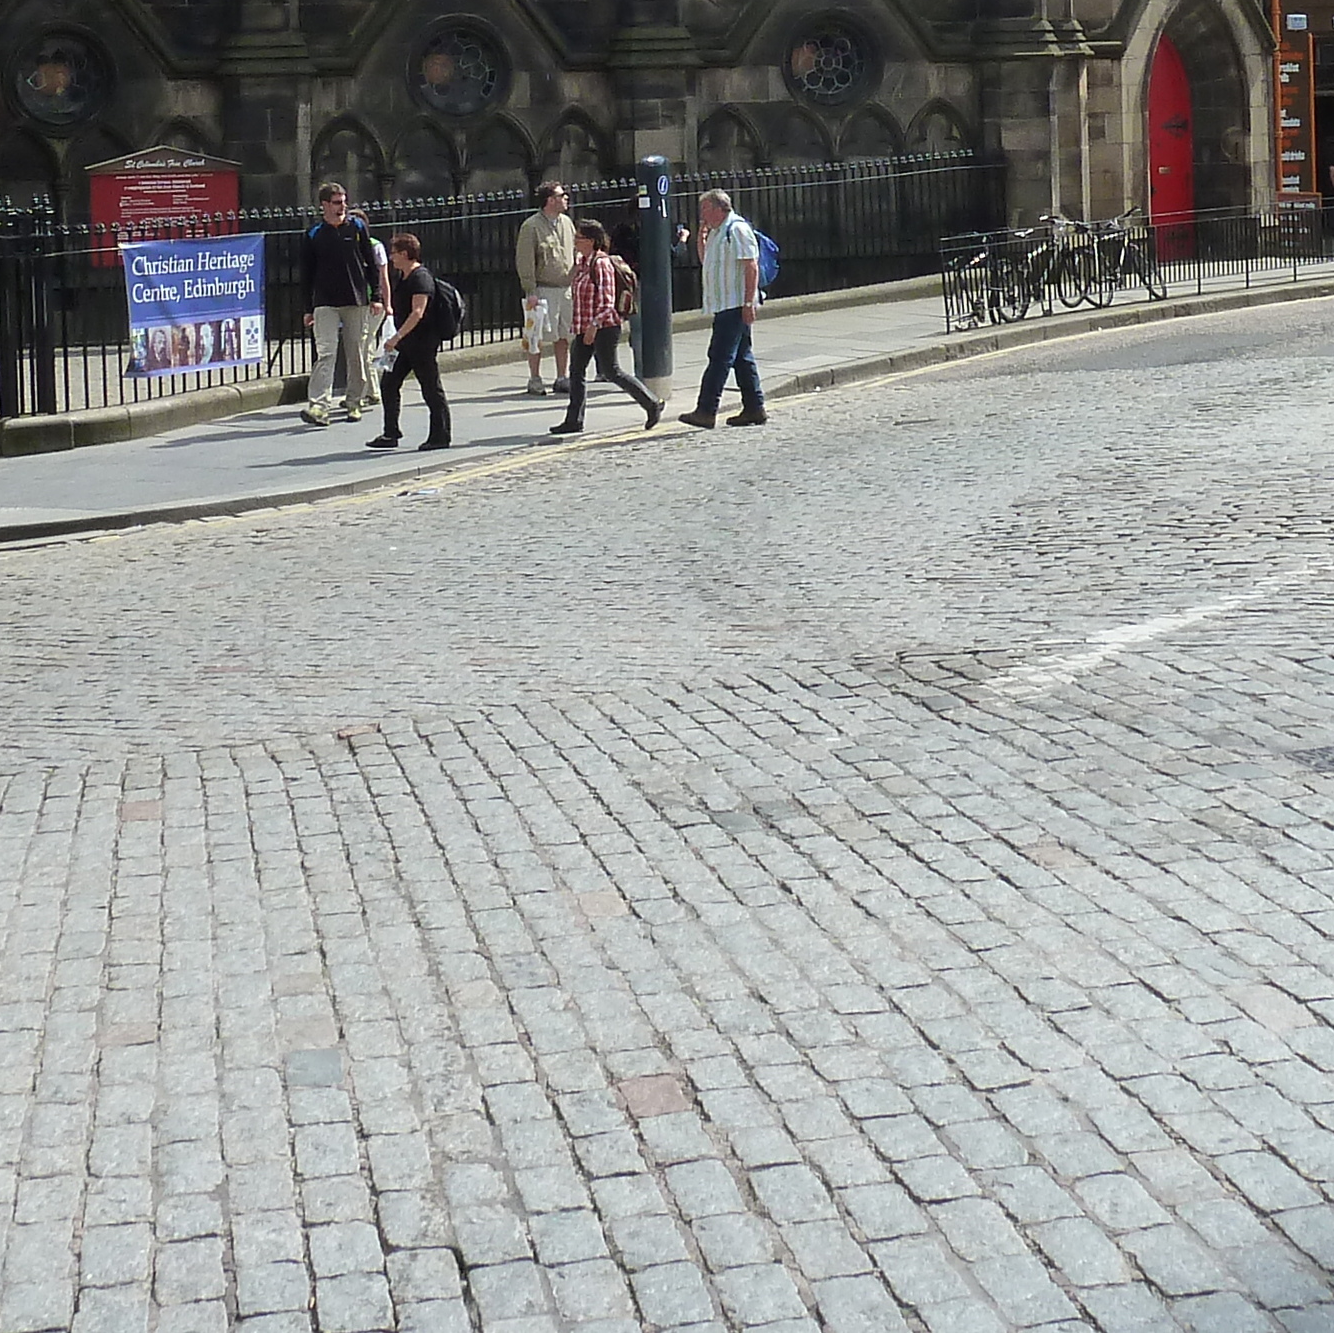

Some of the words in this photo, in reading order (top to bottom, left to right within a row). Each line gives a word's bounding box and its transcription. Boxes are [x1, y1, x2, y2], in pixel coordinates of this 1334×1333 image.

[131, 254, 194, 276] Christian
[196, 250, 255, 273] Heritage
[131, 283, 181, 303] Centre,
[184, 274, 255, 300] Edinburgh
